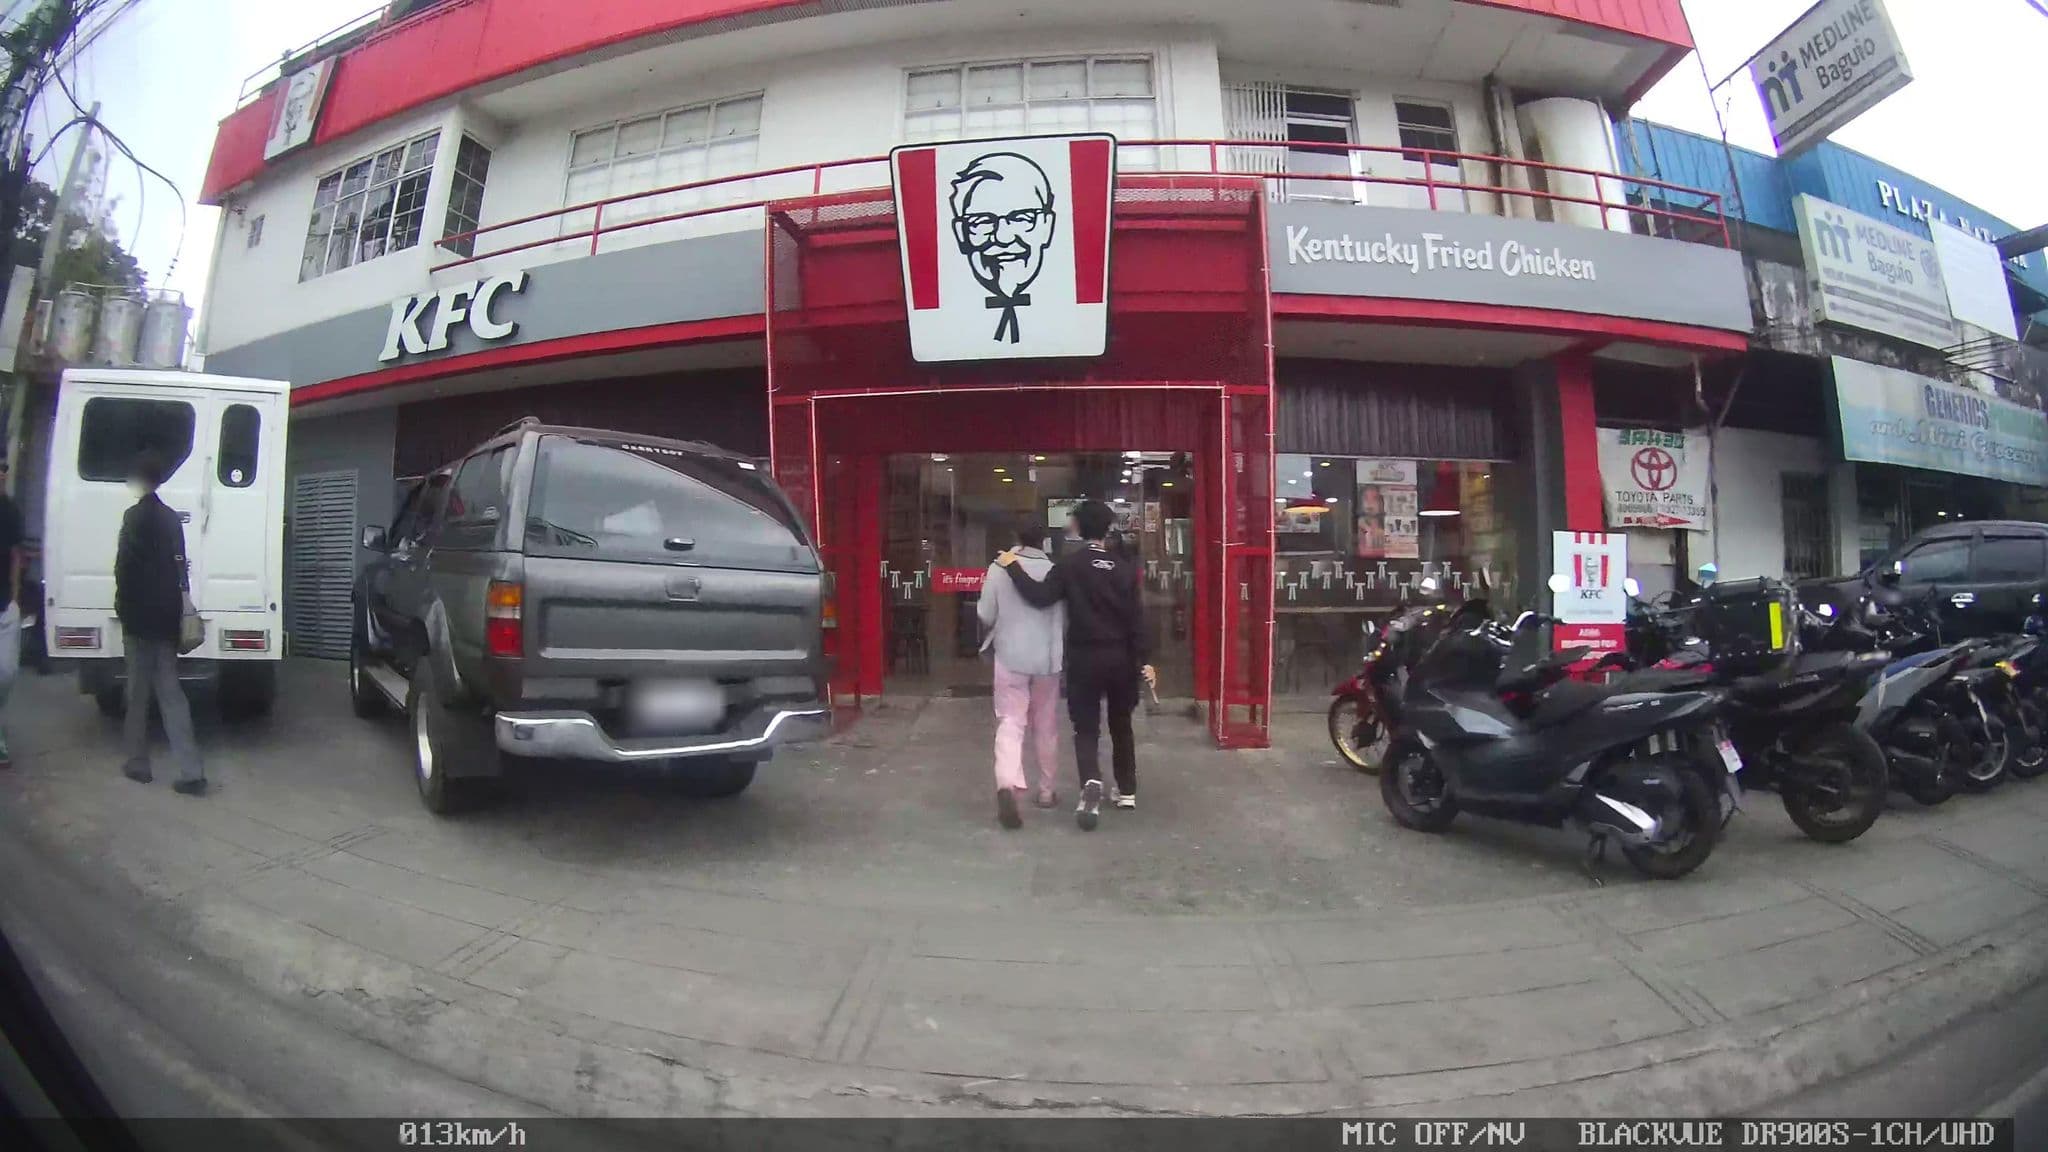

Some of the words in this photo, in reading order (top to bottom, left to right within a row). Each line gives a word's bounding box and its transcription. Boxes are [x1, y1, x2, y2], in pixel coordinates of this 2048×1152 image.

[1799, 0, 1875, 69] MEDLINE
[1815, 37, 1876, 90] Baguio
[1286, 225, 1420, 274] Kentucky
[1422, 232, 1494, 271] Fried
[1499, 239, 1597, 281] Chicken
[1855, 223, 1916, 261] MEDLINE
[1867, 250, 1914, 285] Baguio
[378, 270, 528, 362] KFC
[1924, 384, 1990, 431] GENERICS
[1616, 491, 1658, 503] TOYOTA
[1663, 492, 1694, 505] PARTS
[1580, 589, 1603, 600] KFC
